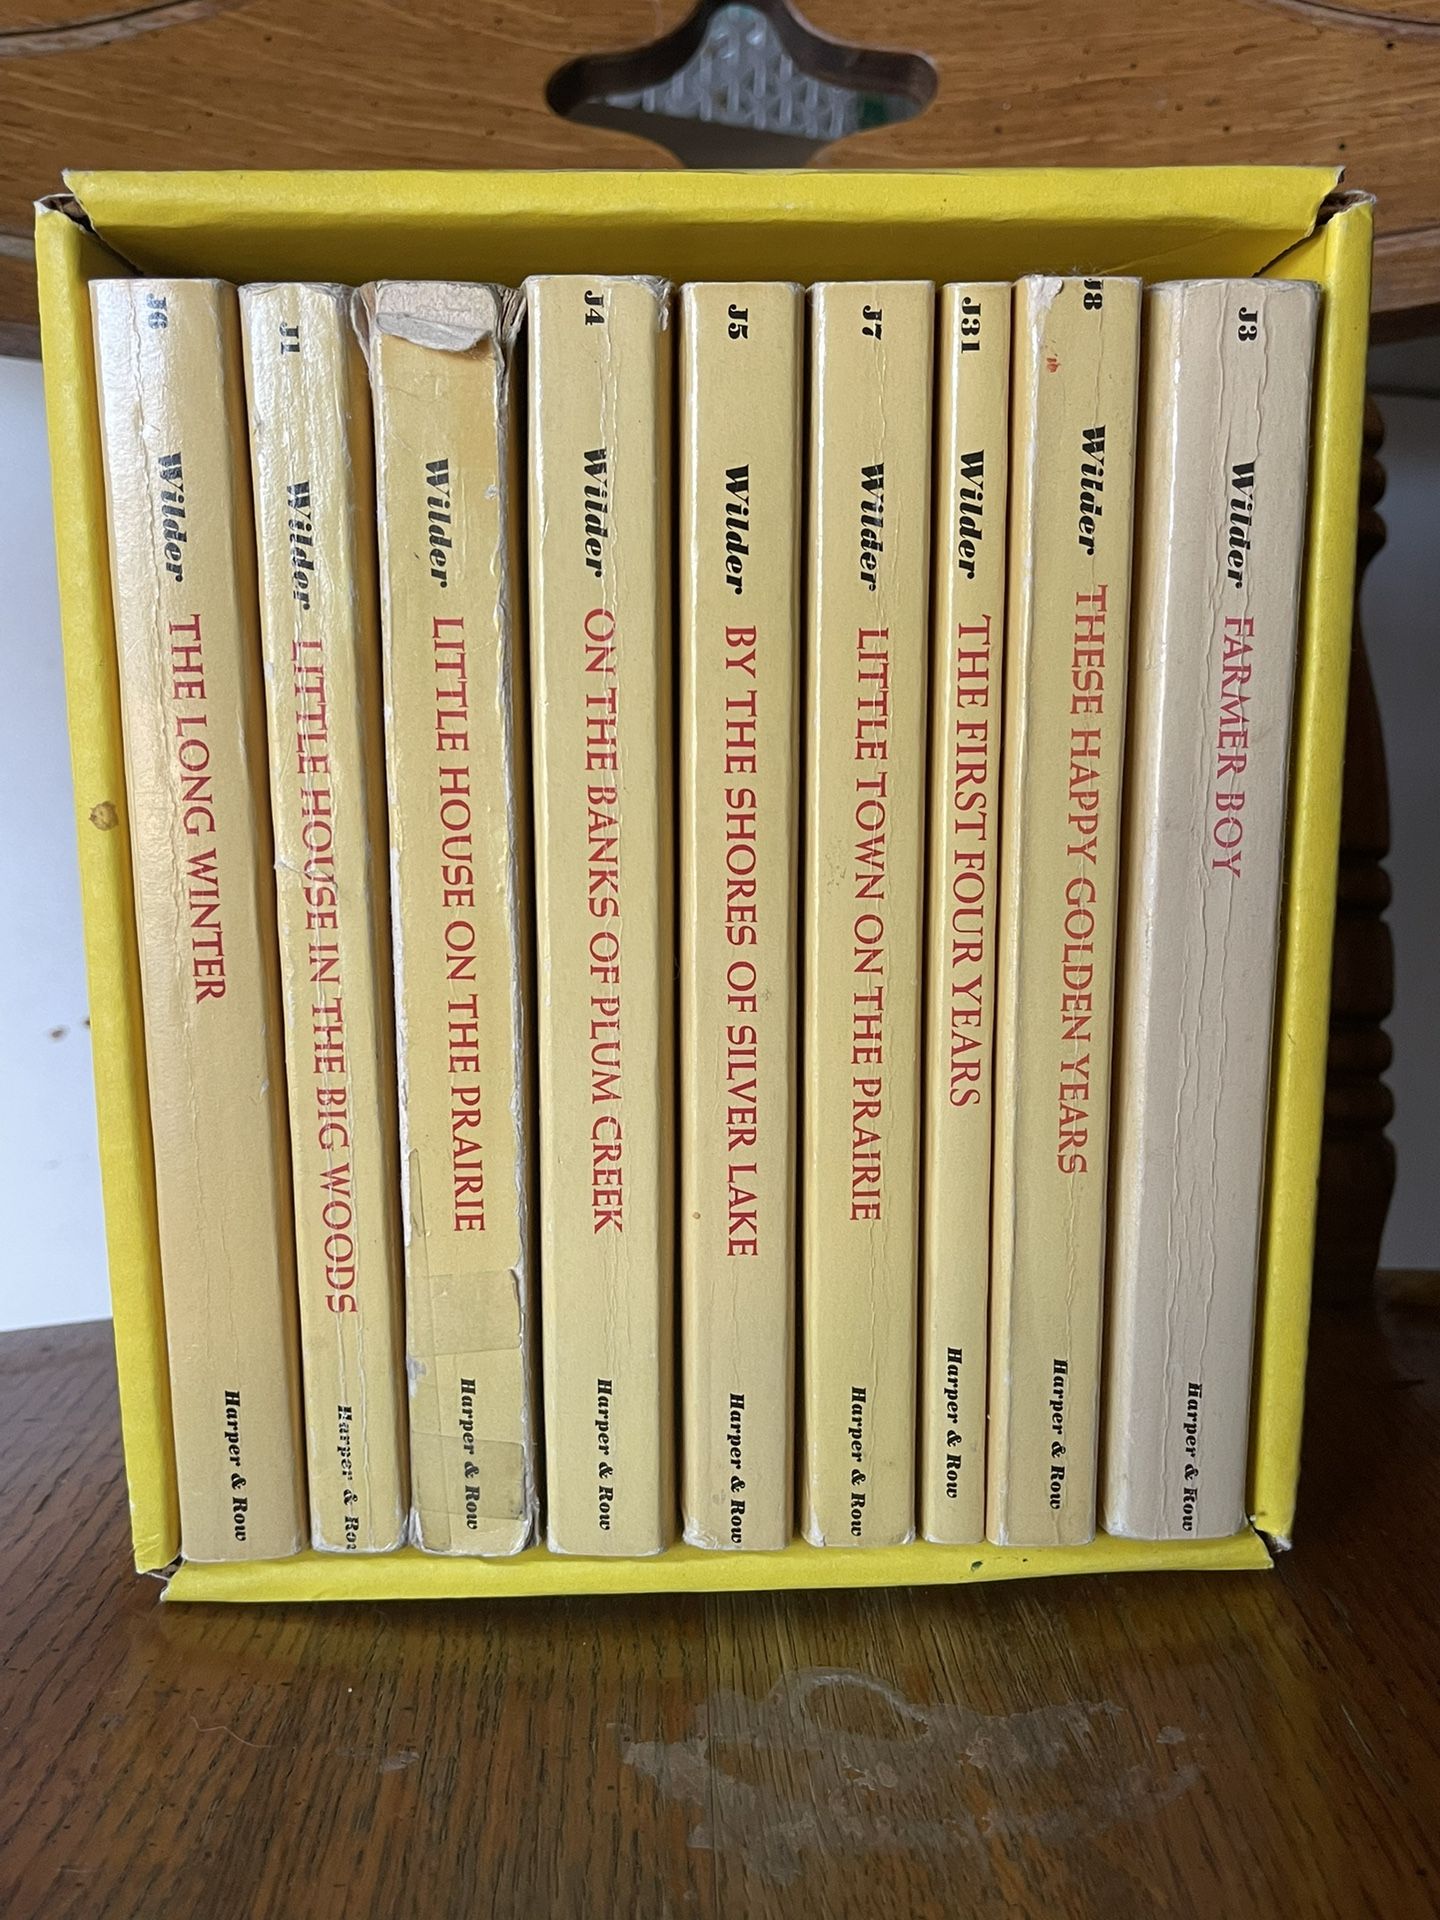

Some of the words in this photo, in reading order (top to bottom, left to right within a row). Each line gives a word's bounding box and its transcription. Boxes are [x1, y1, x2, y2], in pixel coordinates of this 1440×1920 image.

[146, 293, 168, 329] J6
[584, 290, 605, 326] J4
[727, 304, 749, 340] J5
[861, 305, 883, 341] J7
[1083, 278, 1104, 310] J8
[1237, 306, 1258, 342] J3
[158, 452, 188, 583] Wilder
[425, 458, 452, 589] Wilder
[583, 447, 608, 578] Wilder
[725, 464, 750, 595] Wilder
[860, 462, 885, 592] Wilder
[958, 449, 985, 579] Wilder
[1077, 424, 1106, 556] Wilder
[1227, 461, 1256, 589] Wilder
[286, 480, 315, 611] Wilder
[169, 613, 207, 700] THE
[584, 608, 616, 675] ON
[725, 625, 757, 679] BY
[956, 614, 992, 708] THE
[1070, 584, 1109, 715] THESE
[291, 639, 331, 774] LITTLE
[431, 616, 470, 752] LITTLE
[854, 627, 889, 760] LITTLE
[1215, 616, 1254, 780] FARMER
[584, 687, 619, 771] THE
[724, 690, 758, 774] THE
[175, 715, 216, 837] LONG
[954, 720, 988, 841] FIRST
[1066, 728, 1101, 866] HAPPY
[300, 787, 339, 930] HOUSE
[438, 766, 475, 908] HOUSE
[586, 785, 620, 918] BANKS
[725, 788, 758, 946] SHORES
[854, 772, 888, 900] TOWN
[1211, 791, 1246, 879] BOY
[186, 848, 227, 1004] WINTER
[853, 914, 884, 975] ON
[952, 850, 985, 968] FOUR
[308, 943, 341, 985] IN
[444, 921, 477, 982] ON
[589, 932, 620, 985] OF
[726, 961, 758, 1013] OF
[1061, 877, 1096, 1042] GOLDEN
[311, 997, 345, 1074] THE
[447, 993, 481, 1073] THE
[589, 995, 622, 1105] PLUM
[850, 986, 884, 1065] THE
[949, 975, 983, 1108] YEARS
[315, 1086, 350, 1151] BIG
[726, 1025, 758, 1152] SILVER
[1056, 1053, 1090, 1175] YEARS
[450, 1085, 485, 1232] PRAIRIE
[590, 1116, 623, 1235] CREEK
[849, 1077, 882, 1221] PRAIRIE
[319, 1163, 358, 1314] WOODS
[726, 1163, 758, 1257] LAKE
[458, 1378, 477, 1455] Harper
[595, 1378, 613, 1456] Harper
[848, 1386, 867, 1462] Harper
[943, 1347, 963, 1424] Harper
[1049, 1359, 1068, 1435] Harper
[1183, 1382, 1203, 1458] Harper
[224, 1390, 241, 1467] Harper
[727, 1393, 745, 1470] Harper
[946, 1429, 962, 1447] &
[1050, 1440, 1066, 1458] &
[231, 1473, 247, 1490] &
[343, 1488, 359, 1506] &
[464, 1461, 480, 1478] &
[464, 1485, 480, 1530] Row
[598, 1461, 614, 1479] &
[598, 1486, 614, 1531] Row
[730, 1475, 746, 1493] &
[851, 1468, 866, 1486] &
[946, 1454, 962, 1499] Row
[1050, 1465, 1066, 1510] Row
[1184, 1463, 1200, 1481] &
[232, 1497, 248, 1542] Row
[730, 1499, 746, 1544] Row
[850, 1493, 866, 1537] Row
[1182, 1488, 1198, 1532] Row
